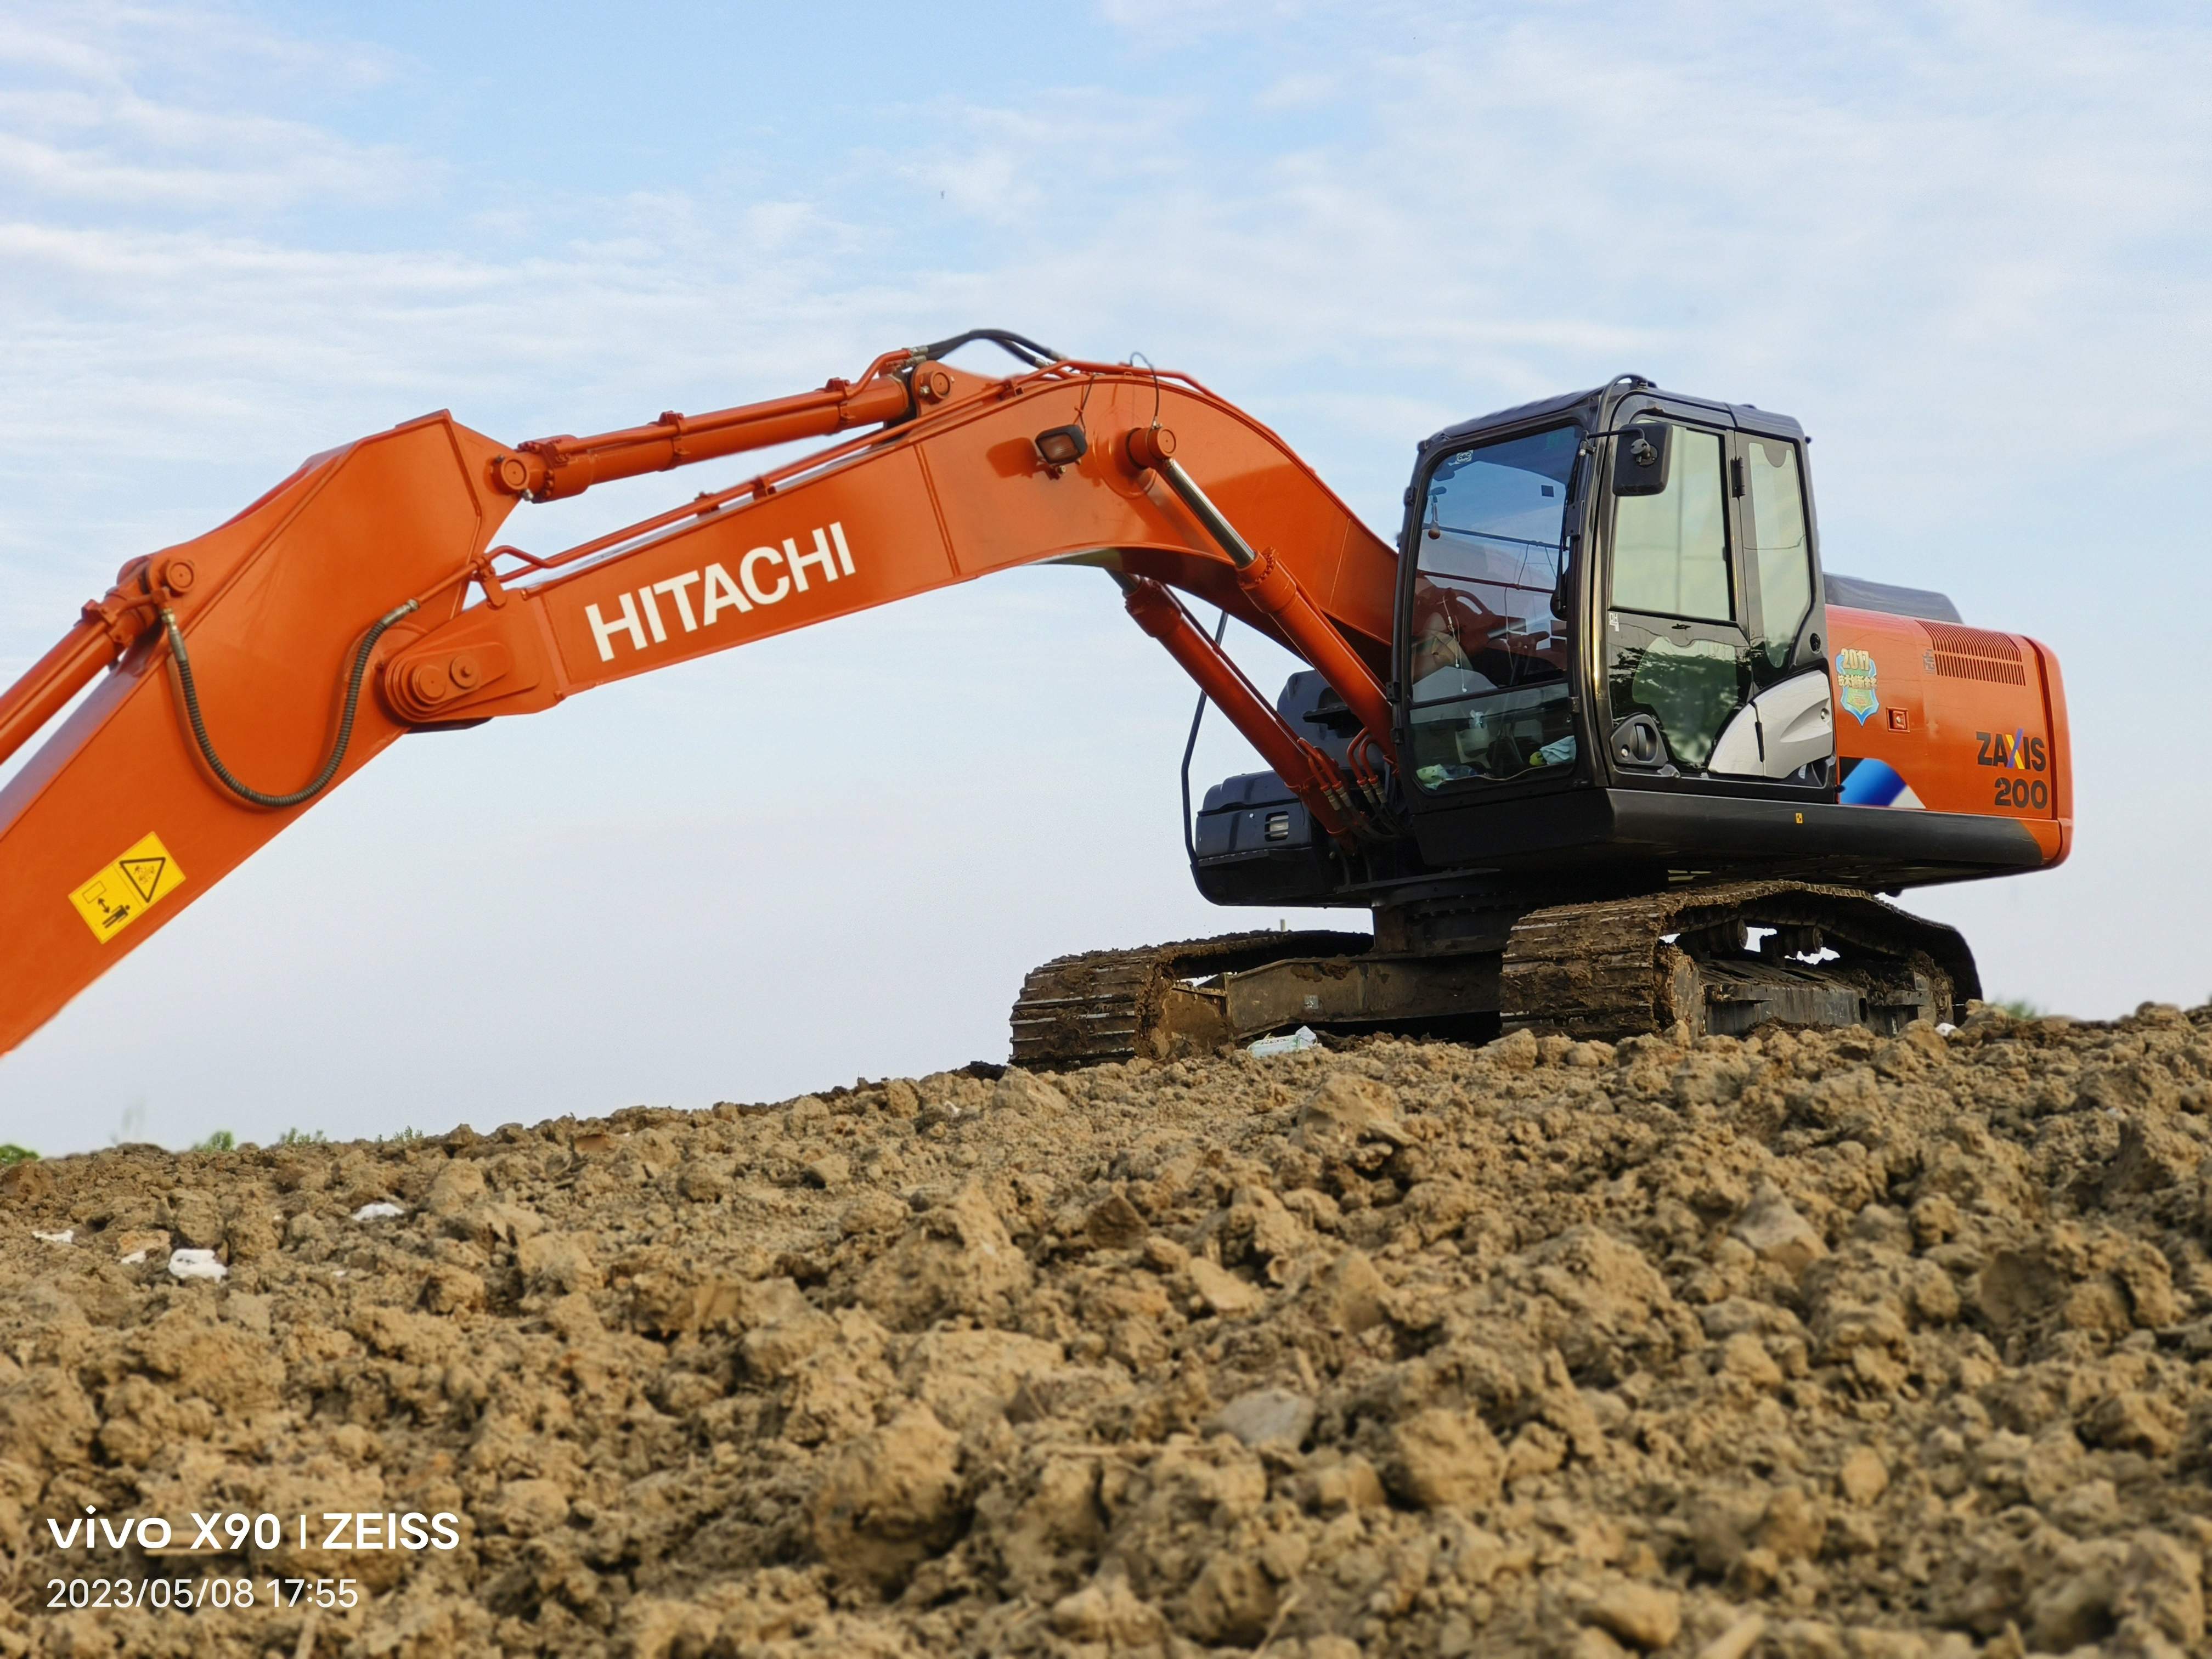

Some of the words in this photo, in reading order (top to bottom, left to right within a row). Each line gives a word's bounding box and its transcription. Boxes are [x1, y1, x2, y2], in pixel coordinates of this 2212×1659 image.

[585, 522, 856, 662] HITACHI
[1841, 648, 1870, 671] 2017
[1976, 728, 2046, 772] ZAXIS
[1994, 777, 2048, 809] 200
